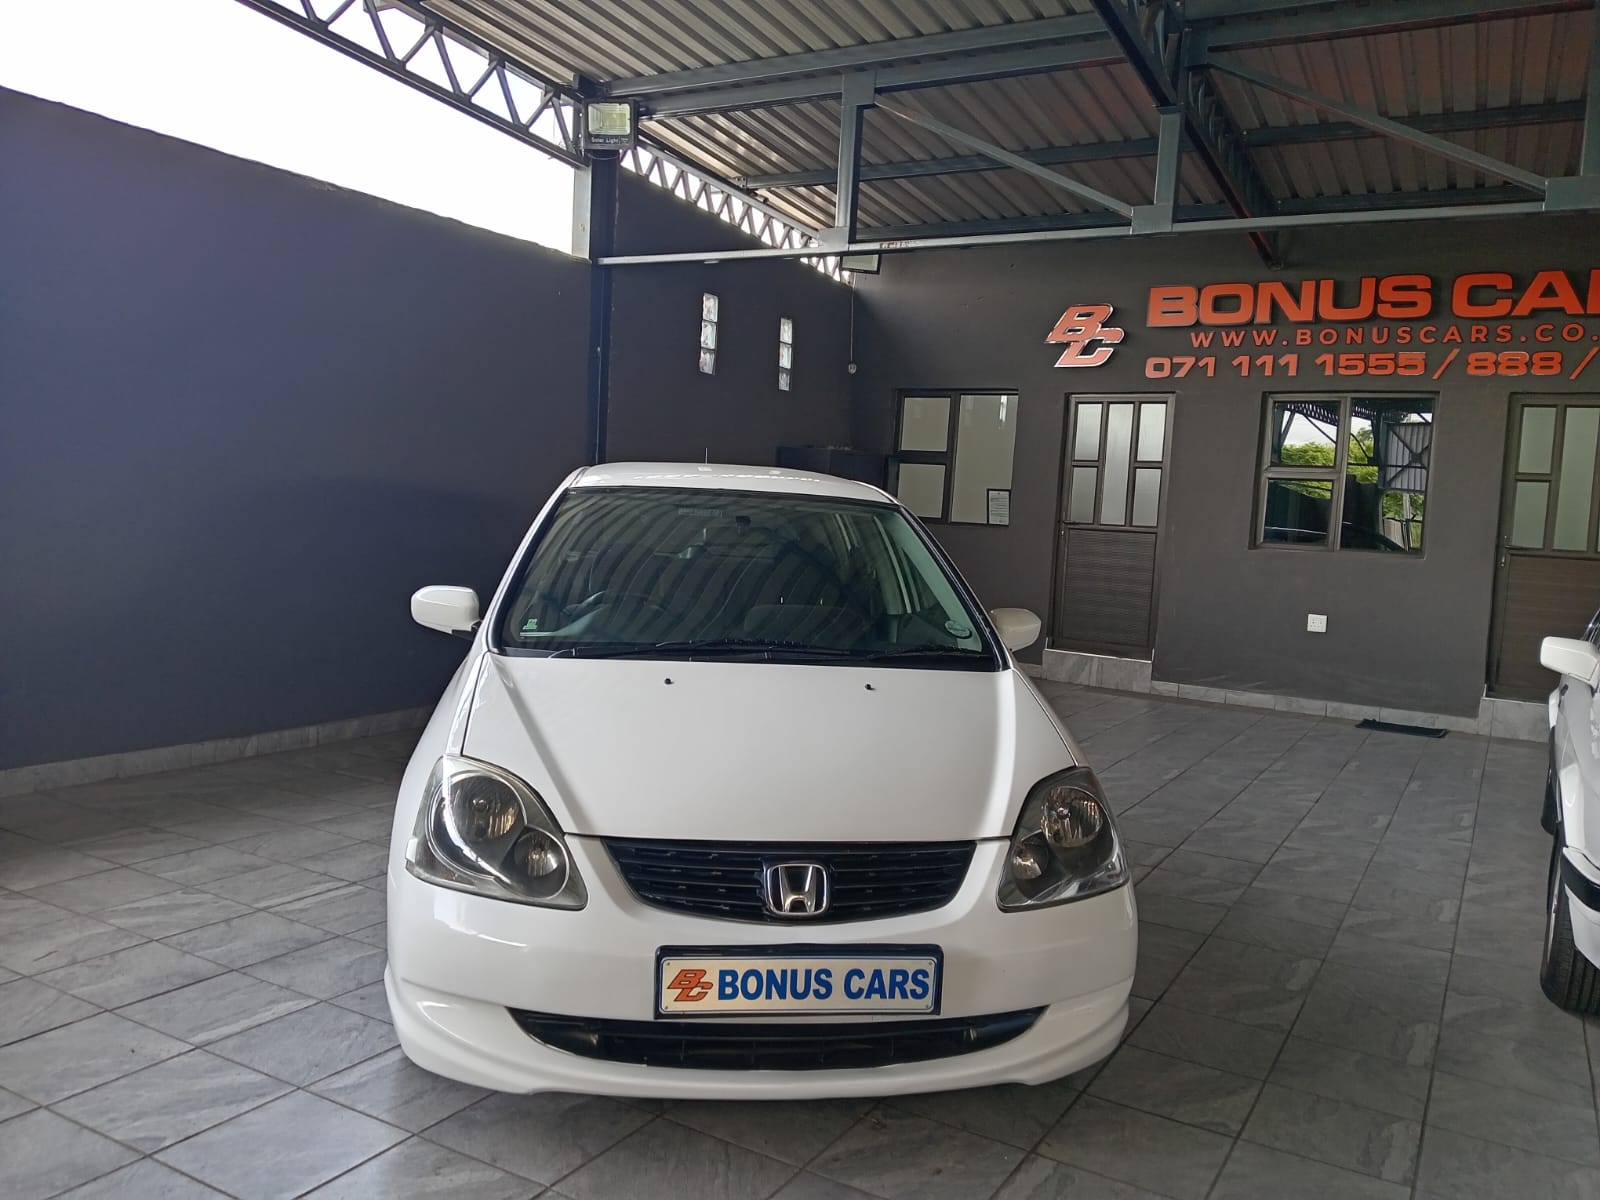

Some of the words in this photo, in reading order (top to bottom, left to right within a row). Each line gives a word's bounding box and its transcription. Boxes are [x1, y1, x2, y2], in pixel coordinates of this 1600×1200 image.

[1147, 275, 1432, 327] BONUS
[1452, 269, 1600, 318] CA
[1145, 356, 1216, 378] 071
[1232, 354, 1298, 377] 111
[717, 968, 833, 1001] BONUS
[843, 968, 930, 1000] CARS
